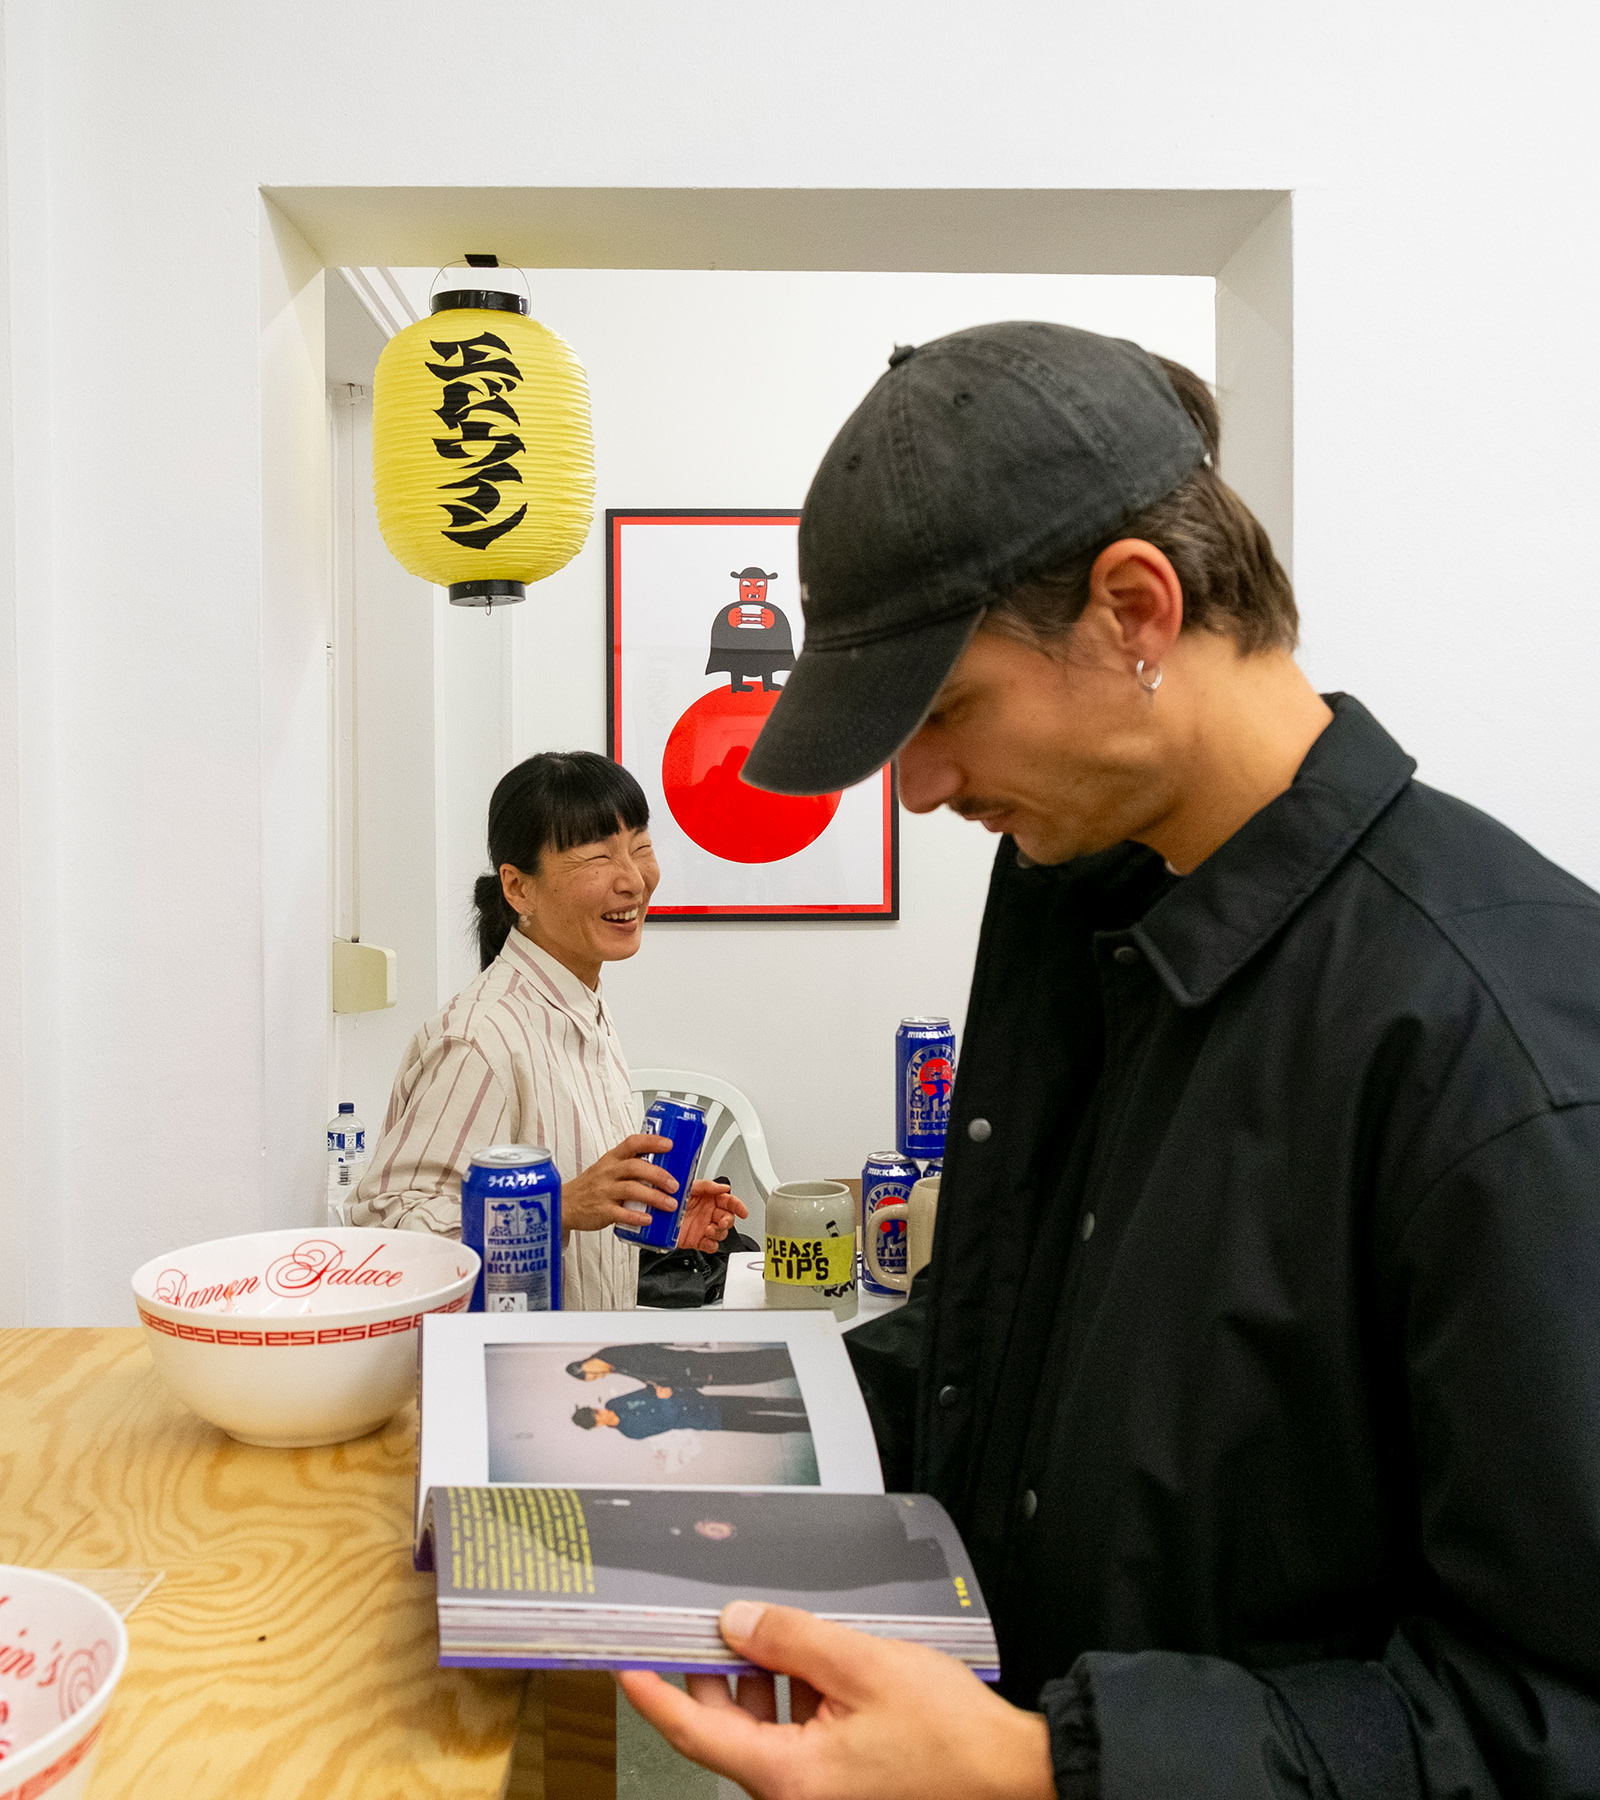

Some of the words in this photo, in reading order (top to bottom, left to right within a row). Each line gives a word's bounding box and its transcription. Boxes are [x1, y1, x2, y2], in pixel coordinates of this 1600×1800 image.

[490, 1246, 546, 1262] JAPANESE
[265, 1239, 404, 1298] Palace
[487, 1263, 511, 1274] RICE
[514, 1258, 548, 1273] LAGER
